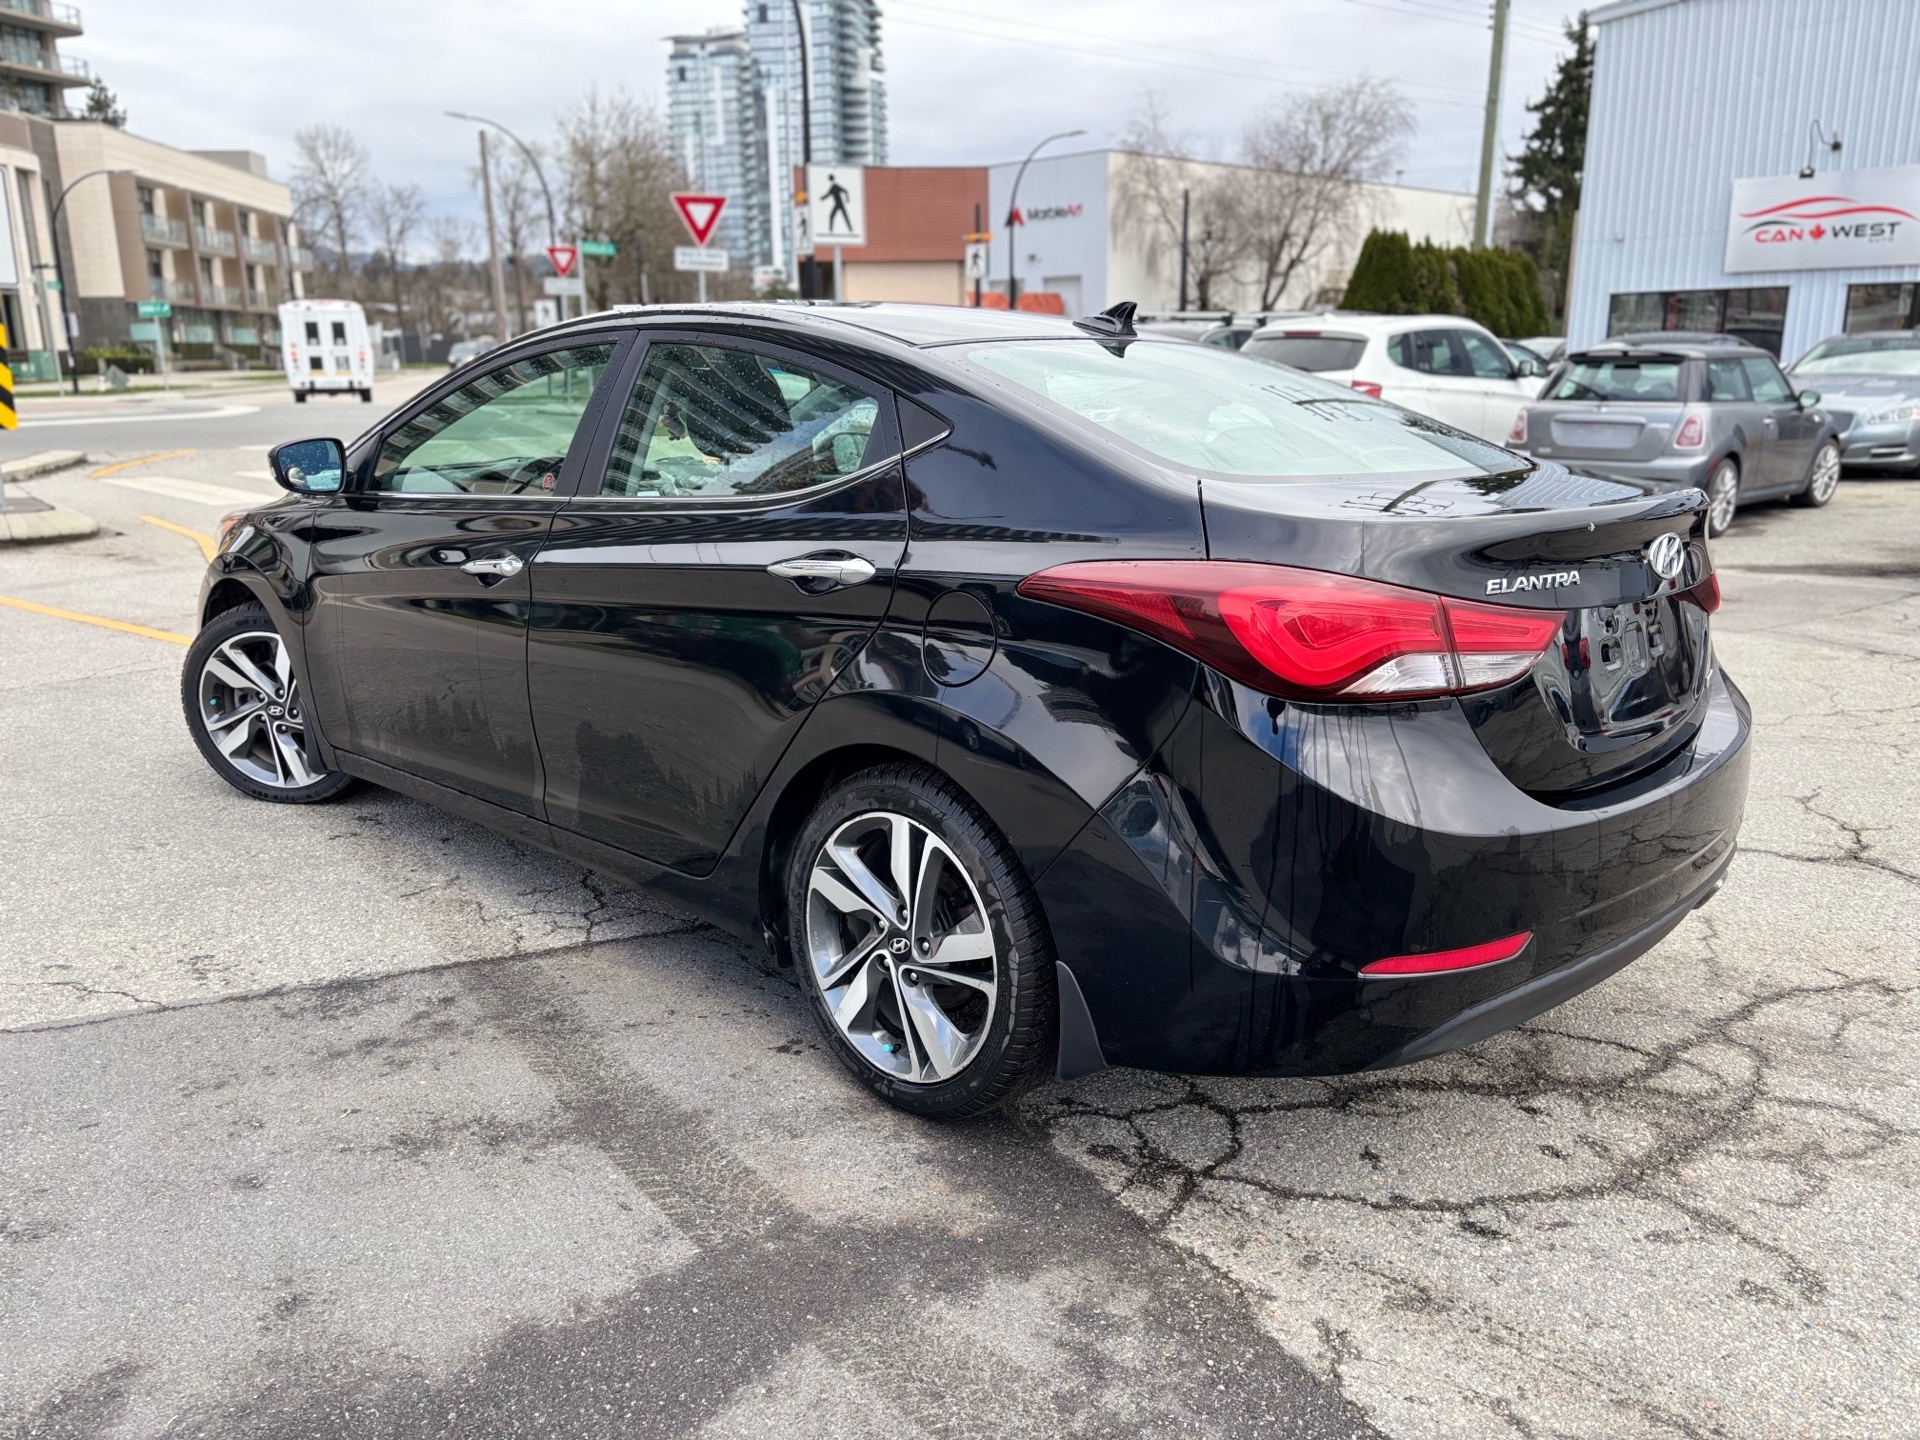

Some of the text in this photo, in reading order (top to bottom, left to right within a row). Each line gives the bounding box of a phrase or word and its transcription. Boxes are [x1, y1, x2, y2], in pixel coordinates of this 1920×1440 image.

[1754, 222, 1901, 243] CAN WEST
[1486, 570, 1580, 595] ELANTRA
